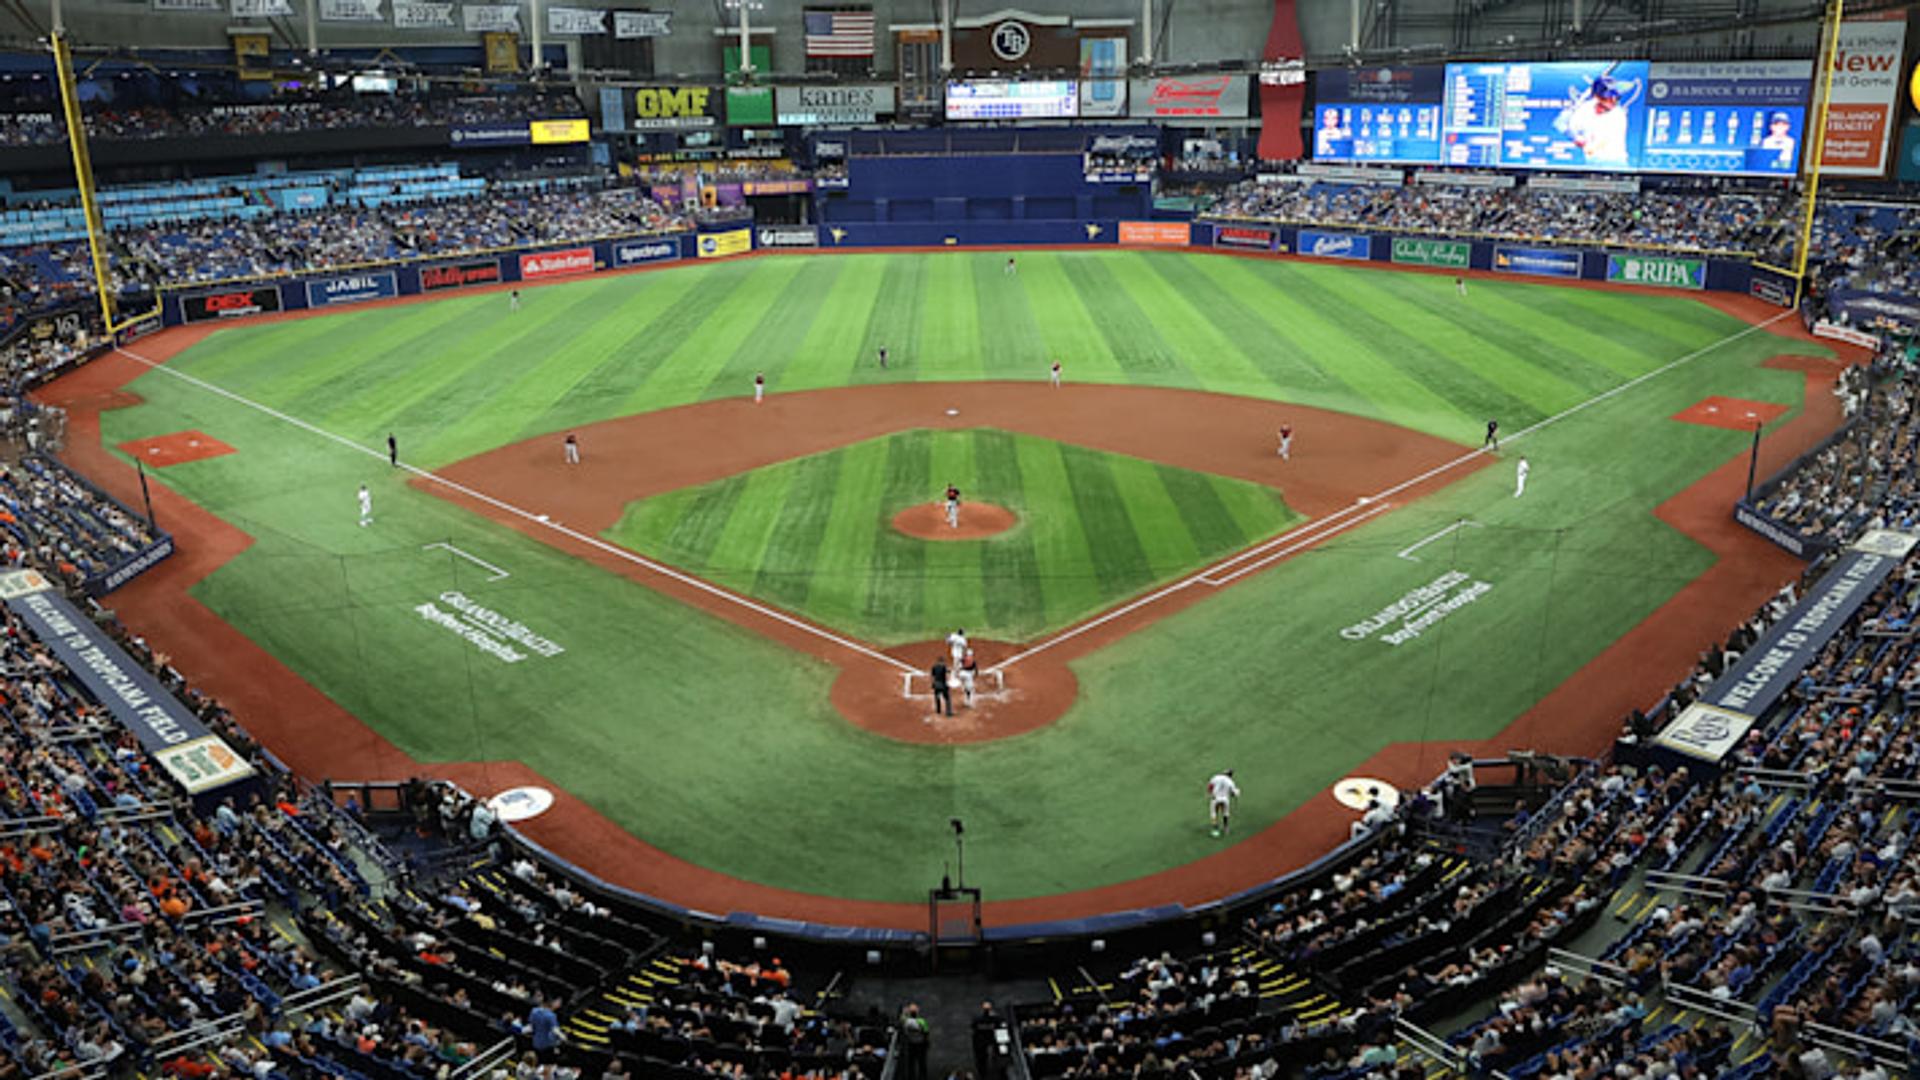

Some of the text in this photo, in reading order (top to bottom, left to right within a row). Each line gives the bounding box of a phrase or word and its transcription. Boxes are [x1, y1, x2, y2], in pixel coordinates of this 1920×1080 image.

[1824, 50, 1896, 73] New
[636, 87, 711, 117] GMF
[1736, 86, 1803, 96] WHITNEY
[620, 244, 672, 261] Spectrum
[1642, 260, 1690, 285] RIPA
[326, 277, 378, 293] JABIL
[205, 292, 255, 311] DEX
[1717, 645, 1793, 710] WELCOME
[1778, 631, 1808, 650] TO
[1799, 573, 1859, 635] TROPICANA
[24, 594, 190, 745] WELCOME TO TROPICANA FIELD
